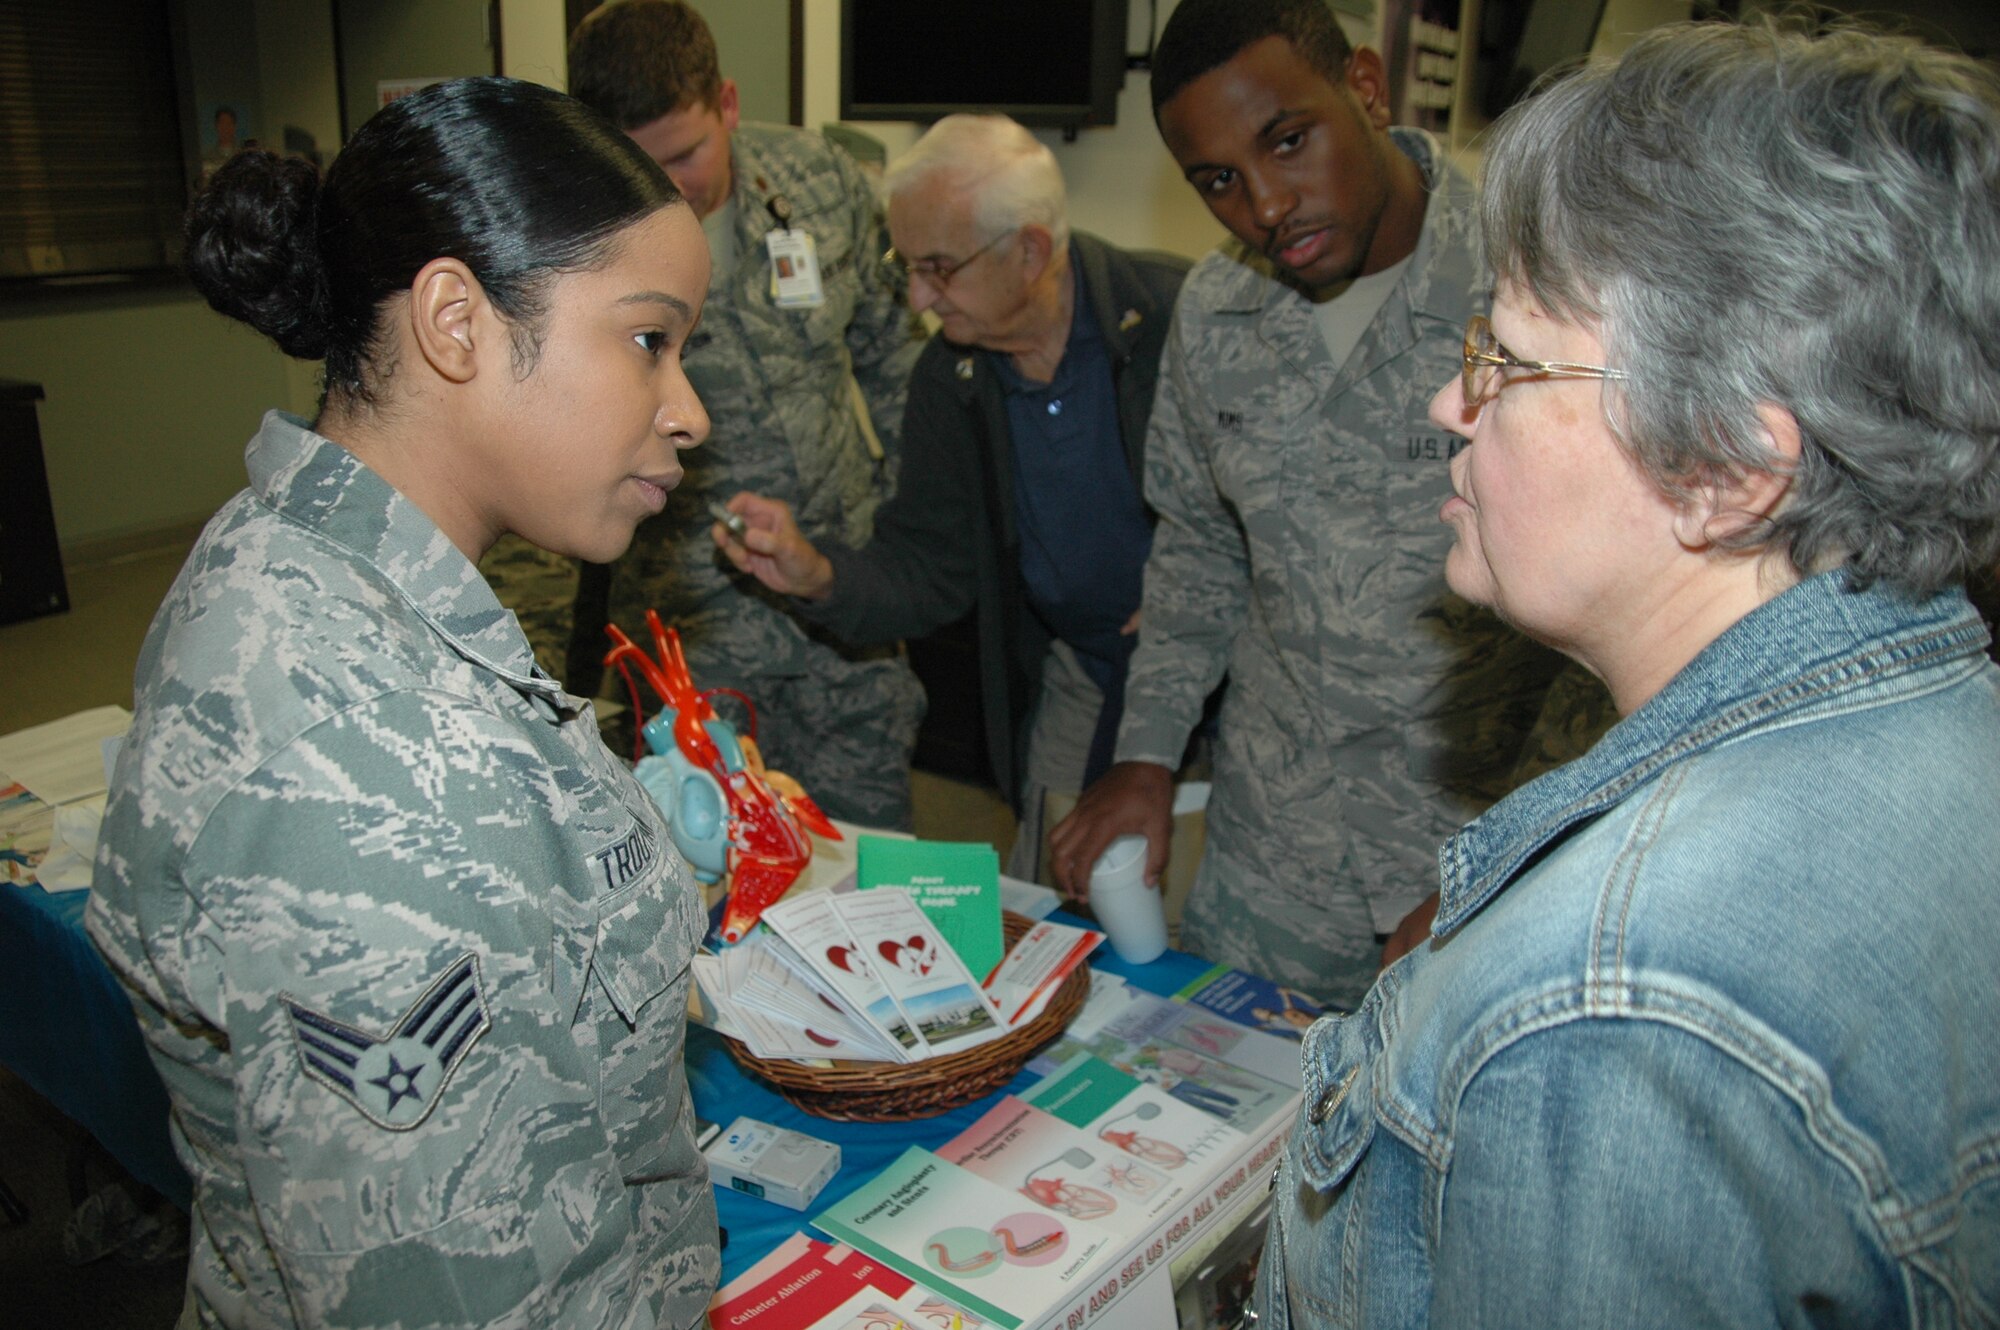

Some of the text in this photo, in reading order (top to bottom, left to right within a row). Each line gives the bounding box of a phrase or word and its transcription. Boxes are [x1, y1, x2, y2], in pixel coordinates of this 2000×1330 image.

[854, 1164, 937, 1225] Coronary Angioplasty
[900, 1186, 930, 1206] Stents
[1088, 1279, 1118, 1317] AND
[1121, 1256, 1145, 1288] SEE
[1146, 1238, 1164, 1265] US
[1165, 1216, 1191, 1250] FOR
[1193, 1197, 1215, 1227] ALL
[1214, 1167, 1246, 1205] YOUR
[730, 1268, 822, 1325] Catheter Ablation
